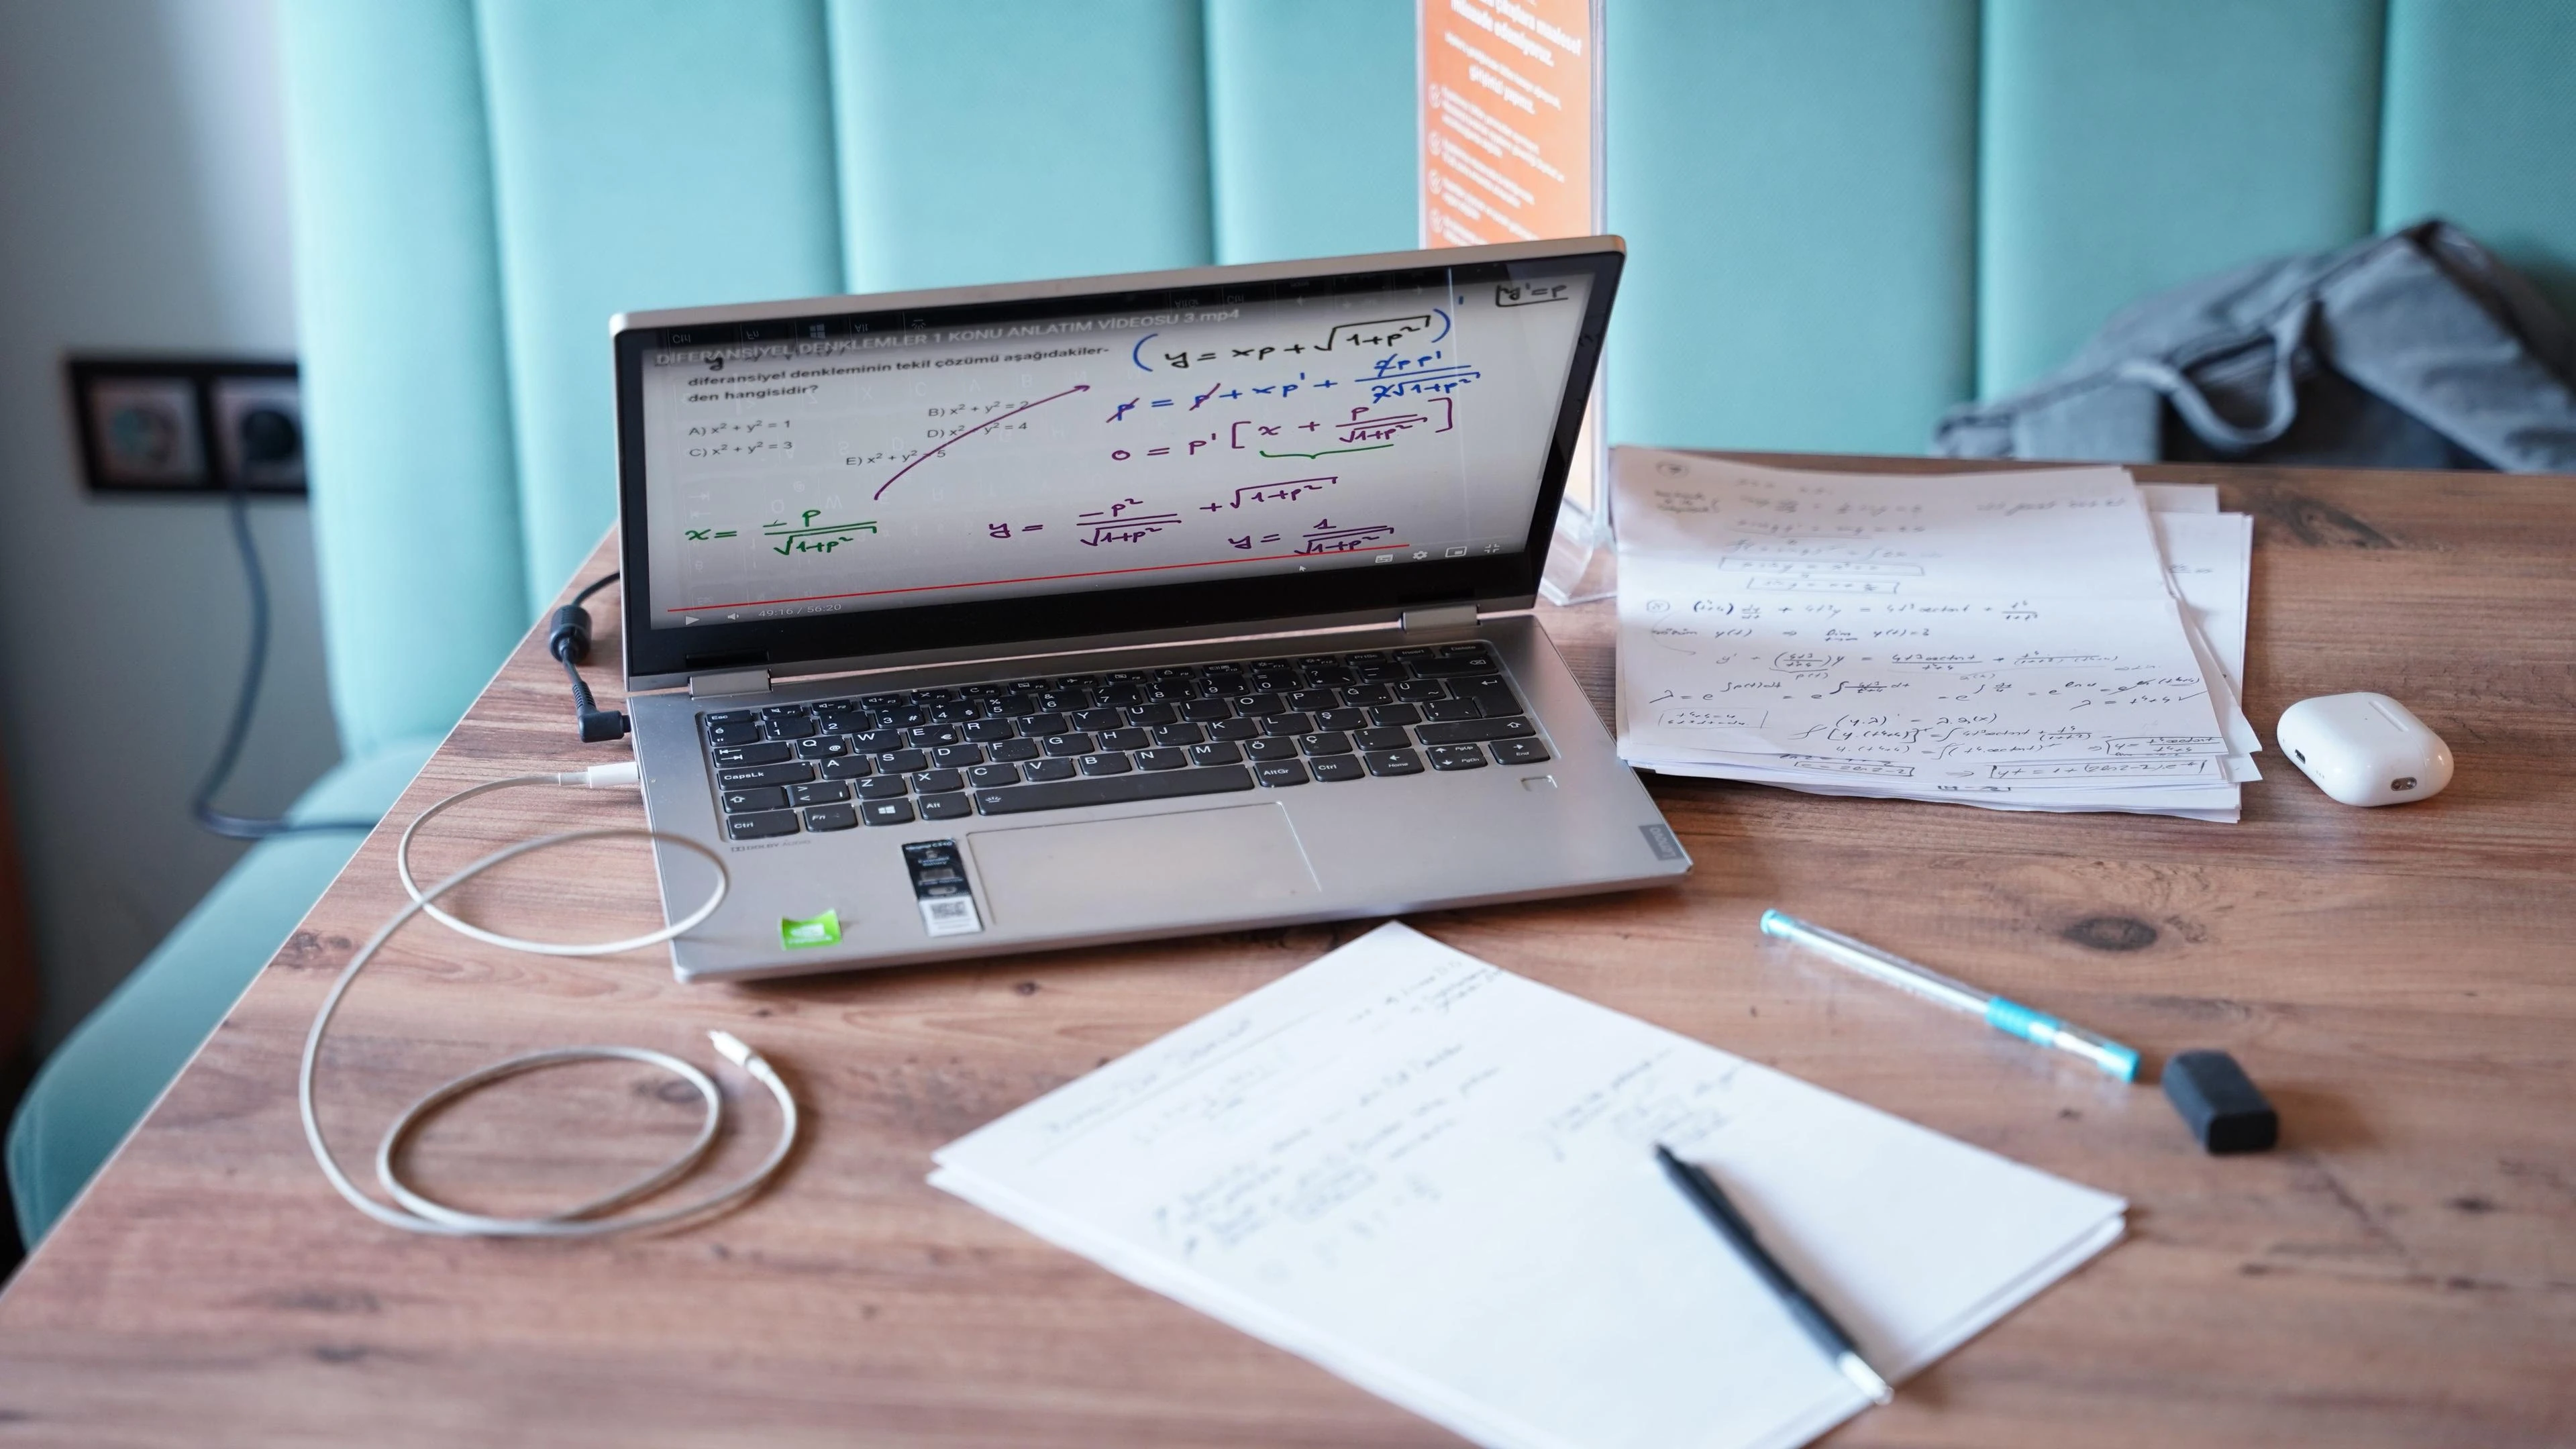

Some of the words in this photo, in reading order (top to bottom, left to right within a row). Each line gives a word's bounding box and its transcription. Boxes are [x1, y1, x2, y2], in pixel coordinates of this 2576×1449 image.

[798, 334, 927, 354] DENKLEMLER
[934, 335, 941, 343] 1
[948, 329, 1002, 343] KONU
[1007, 320, 1092, 337] ANLATIM
[1098, 315, 1178, 330] VİDEOSU
[1184, 309, 1239, 325] 3.mp4
[688, 372, 786, 387] diferansiyel
[790, 363, 891, 379] denkleminin
[896, 360, 931, 370] tekil
[935, 355, 1000, 369] çözümü
[1004, 347, 1110, 362] aşağıdakiler-
[688, 393, 719, 403] den
[725, 384, 819, 400] hangisidir?
[928, 408, 944, 417] B)
[688, 427, 706, 436] A)
[784, 420, 790, 428] 1
[927, 429, 944, 438] D)
[1019, 422, 1027, 430] 4
[689, 448, 707, 458] C)
[784, 441, 792, 449] 3
[845, 457, 862, 466] E)
[937, 449, 946, 458] 5
[758, 608, 793, 618] 49:16
[807, 604, 842, 614] 56:20
[1321, 712, 1332, 720] Ş
[1212, 721, 1226, 729] K
[1159, 727, 1168, 735] J
[1306, 736, 1318, 744] Ç
[1195, 745, 1211, 753] M
[1252, 741, 1265, 749] Ö
[827, 759, 839, 767] A
[1029, 761, 1042, 769] V
[1085, 757, 1098, 765] B
[974, 767, 988, 775] C
[1264, 768, 1290, 776] AltGr
[724, 772, 764, 780] CapsLk
[918, 773, 931, 781] X
[861, 779, 874, 787] Z
